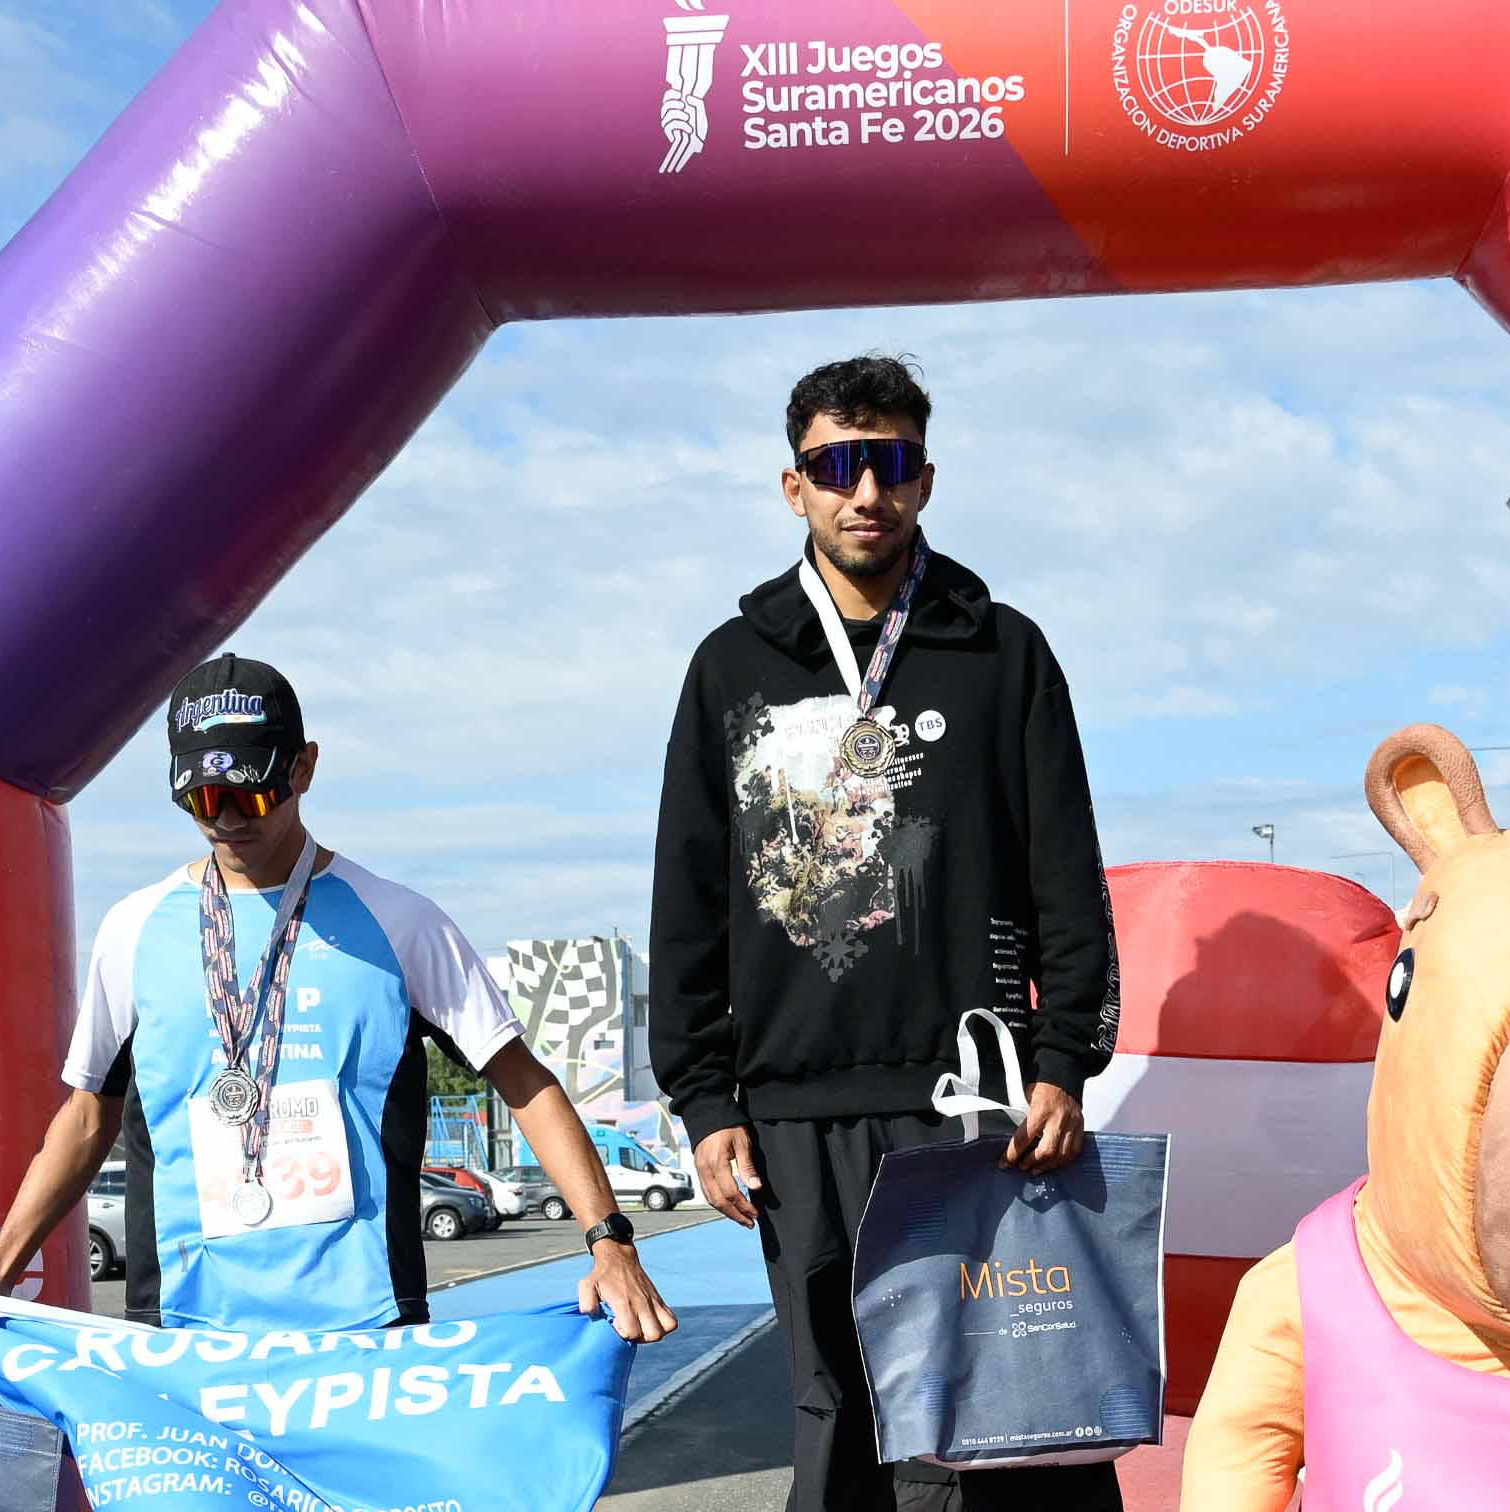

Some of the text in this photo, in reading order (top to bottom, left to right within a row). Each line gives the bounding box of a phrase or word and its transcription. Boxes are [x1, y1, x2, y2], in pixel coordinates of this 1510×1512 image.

[740, 41, 943, 79] XIII Juegos
[1111, 4, 1157, 137] ORGANIZACION
[1156, 126, 1244, 151] DEPORTIVA
[742, 70, 1025, 114] Suramericanos
[743, 105, 1005, 149] Santa Fe 2026
[175, 688, 263, 732] Argentina
[918, 717, 943, 732] TBS
[959, 1258, 1073, 1300] Mista
[76, 1421, 147, 1445] PROF.
[155, 1425, 228, 1450] JUAN
[77, 1446, 219, 1480] FACEBOOK:
[85, 1471, 232, 1508] NSTAGRAM:
